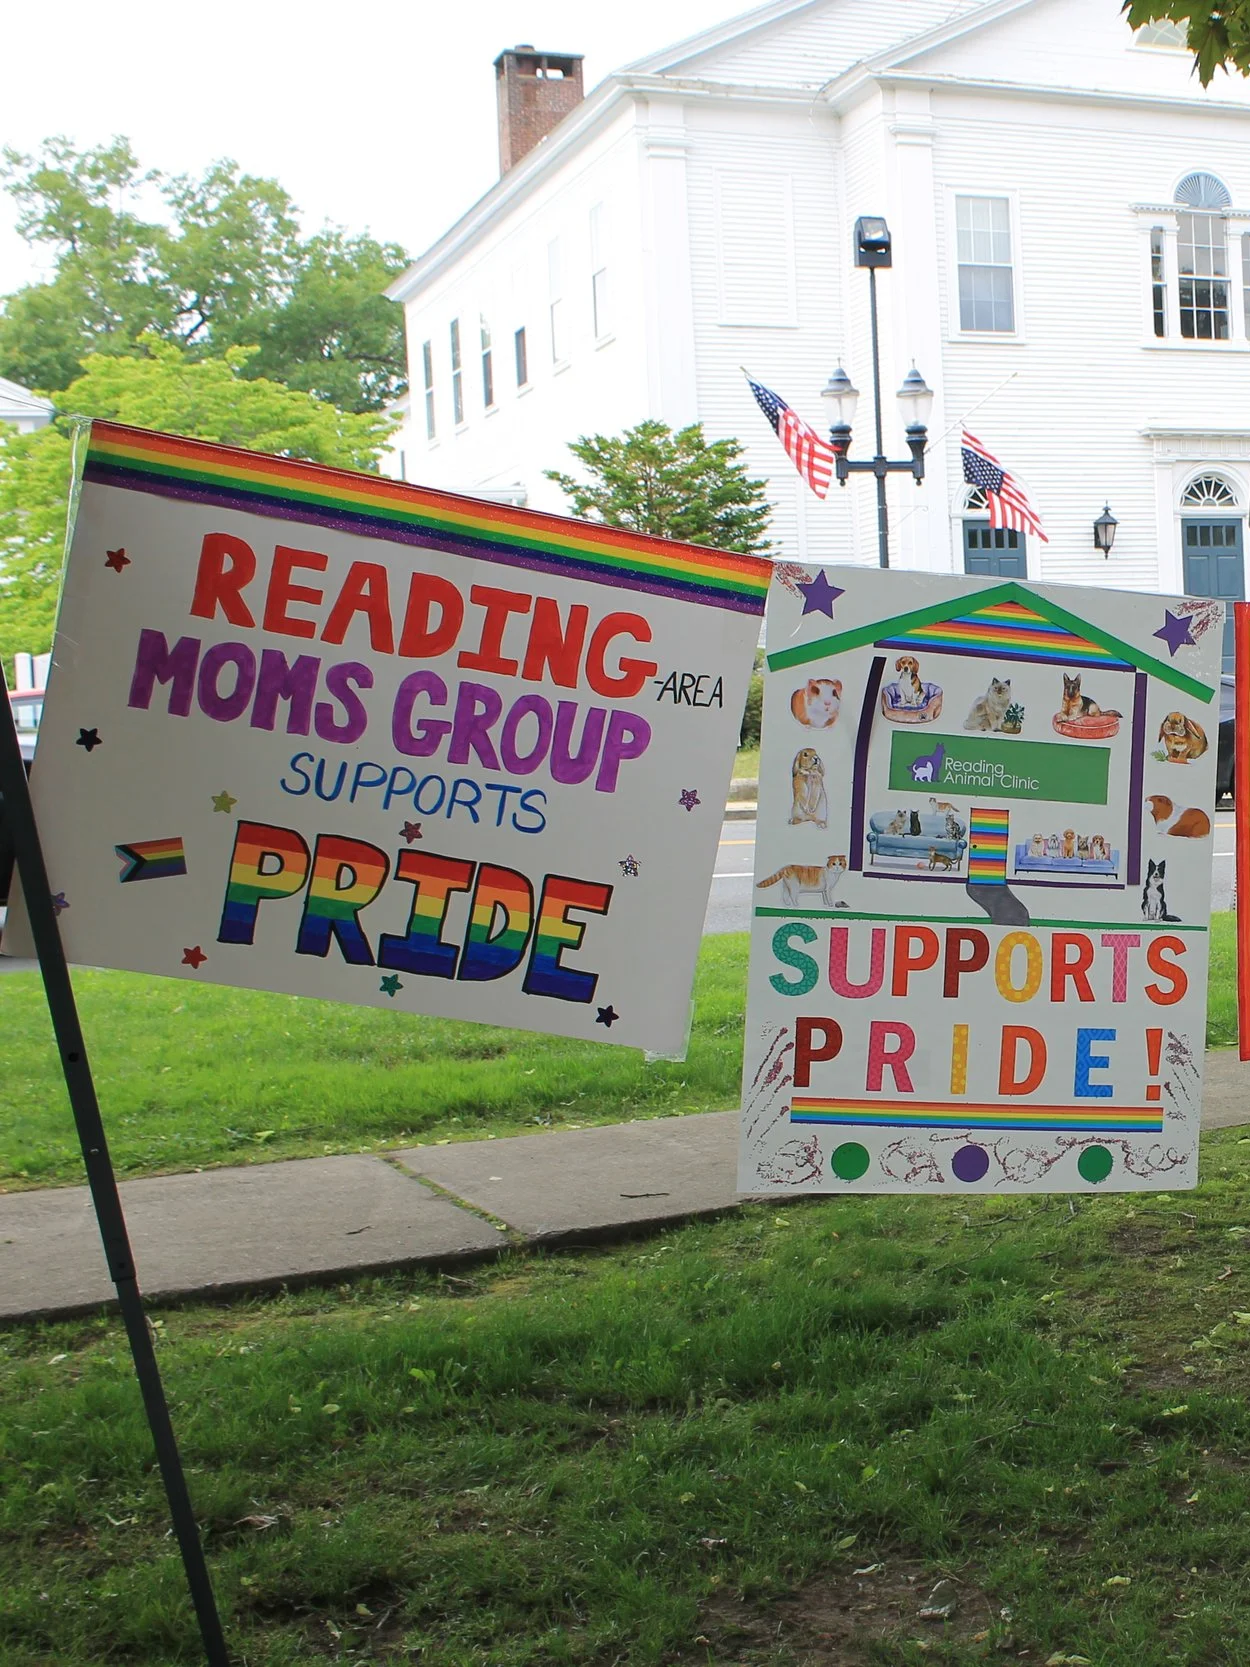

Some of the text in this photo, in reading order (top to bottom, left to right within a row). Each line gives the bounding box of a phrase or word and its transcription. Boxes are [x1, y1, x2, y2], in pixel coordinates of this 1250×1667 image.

[190, 532, 658, 698] READING
[128, 629, 651, 793] MOMS GROUP
[280, 752, 548, 834] SUPPORTS
[943, 771, 1040, 790] Animal Clinic
[945, 757, 1004, 777] Reading
[216, 820, 614, 1003] PRIDE
[768, 923, 1188, 1006] SUPPORTS
[793, 1016, 1164, 1101] PRIDE!
